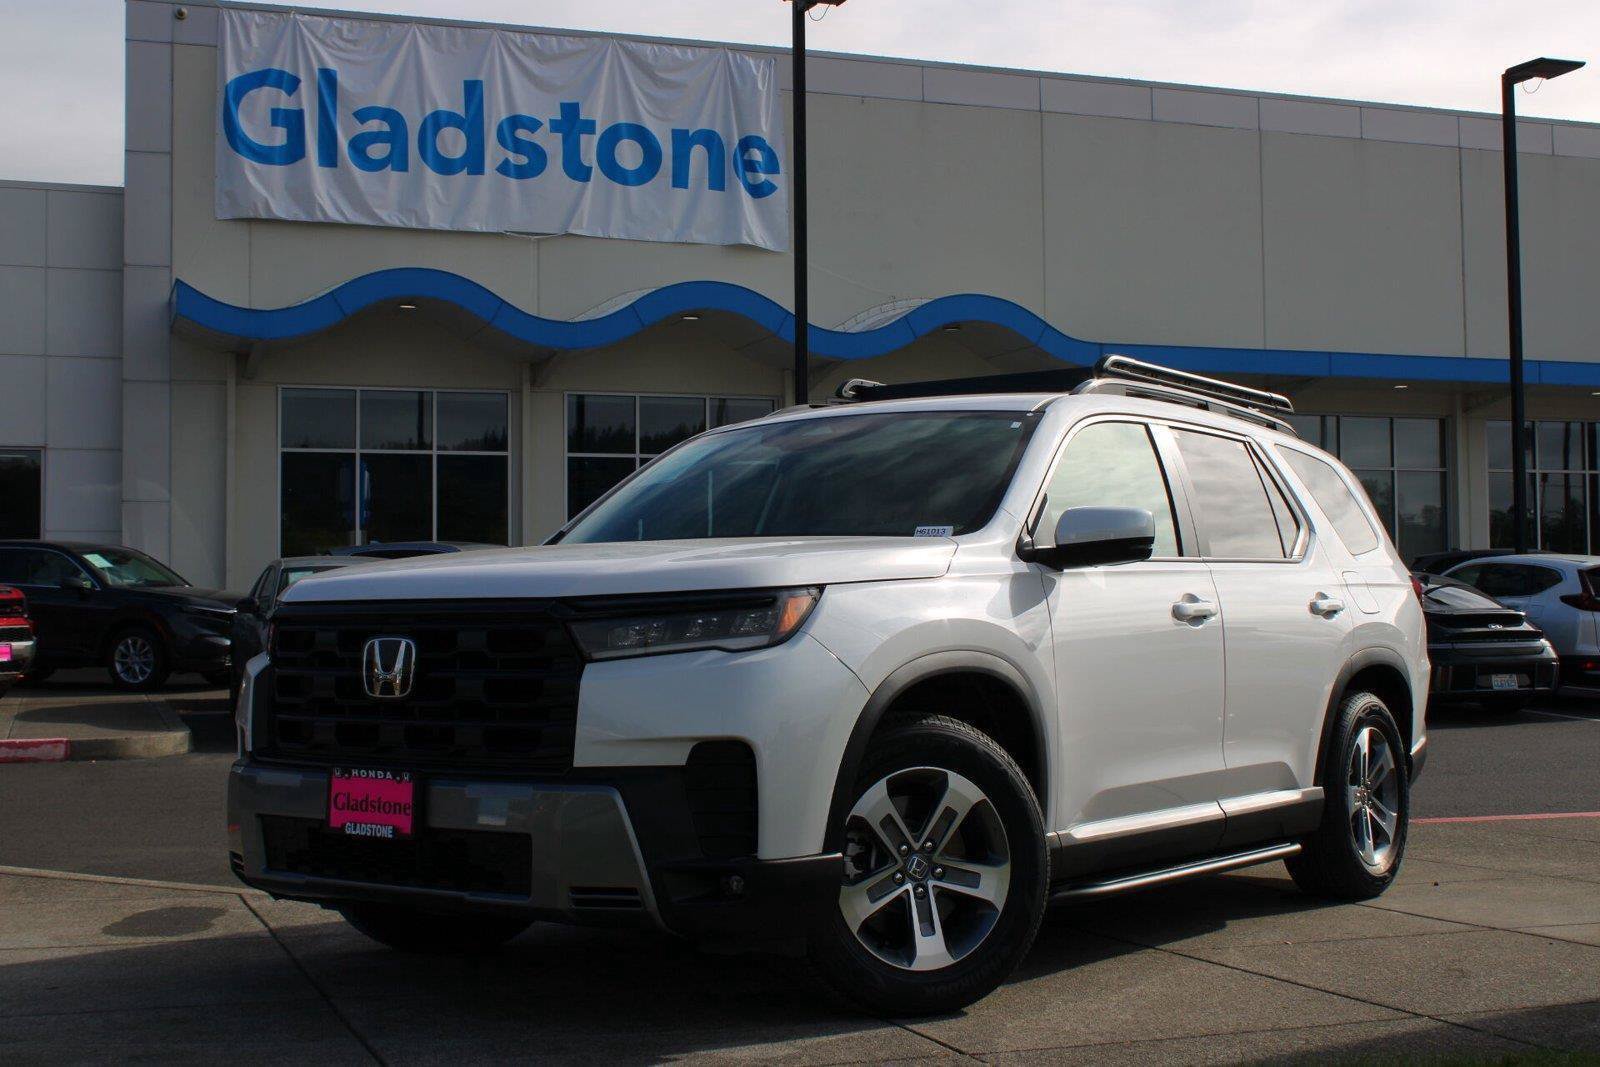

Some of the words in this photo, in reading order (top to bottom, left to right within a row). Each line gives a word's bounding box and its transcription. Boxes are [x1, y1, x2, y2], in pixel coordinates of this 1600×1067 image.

[223, 68, 781, 199] Gladstone
[351, 768, 392, 779] HONDA
[333, 792, 411, 816] Gladstone
[345, 822, 393, 838] GLADSTONE
